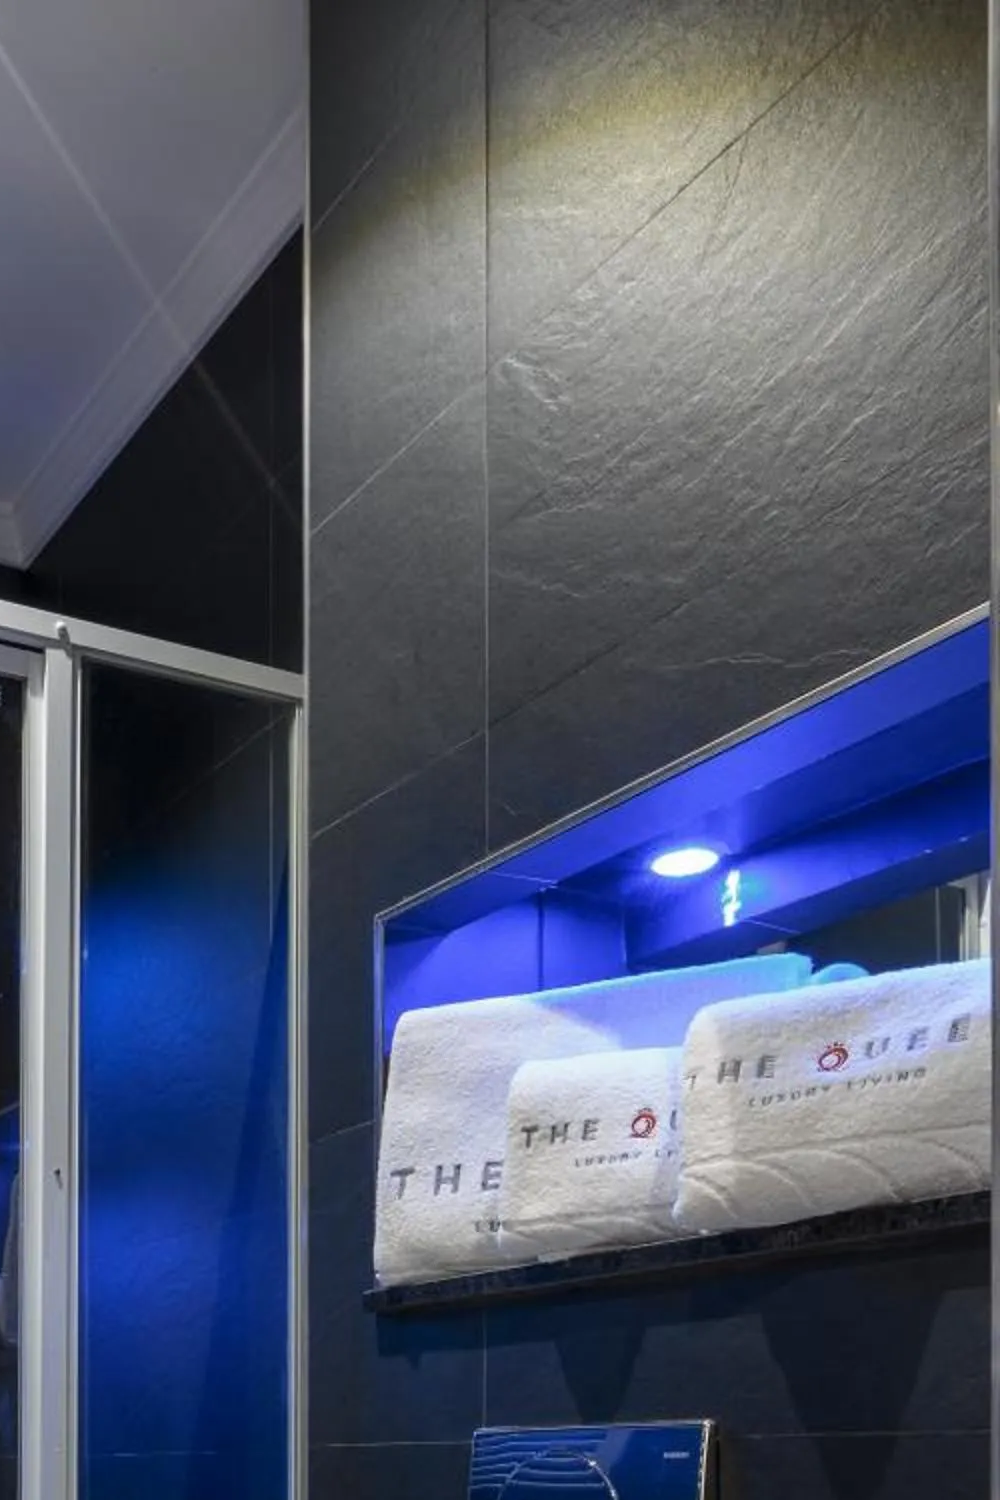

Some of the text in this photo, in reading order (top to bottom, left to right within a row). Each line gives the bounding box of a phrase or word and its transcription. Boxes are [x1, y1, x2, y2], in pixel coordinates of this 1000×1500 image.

[683, 1054, 778, 1091] THE
[520, 1118, 600, 1149] THE
[390, 1160, 502, 1200] THE
